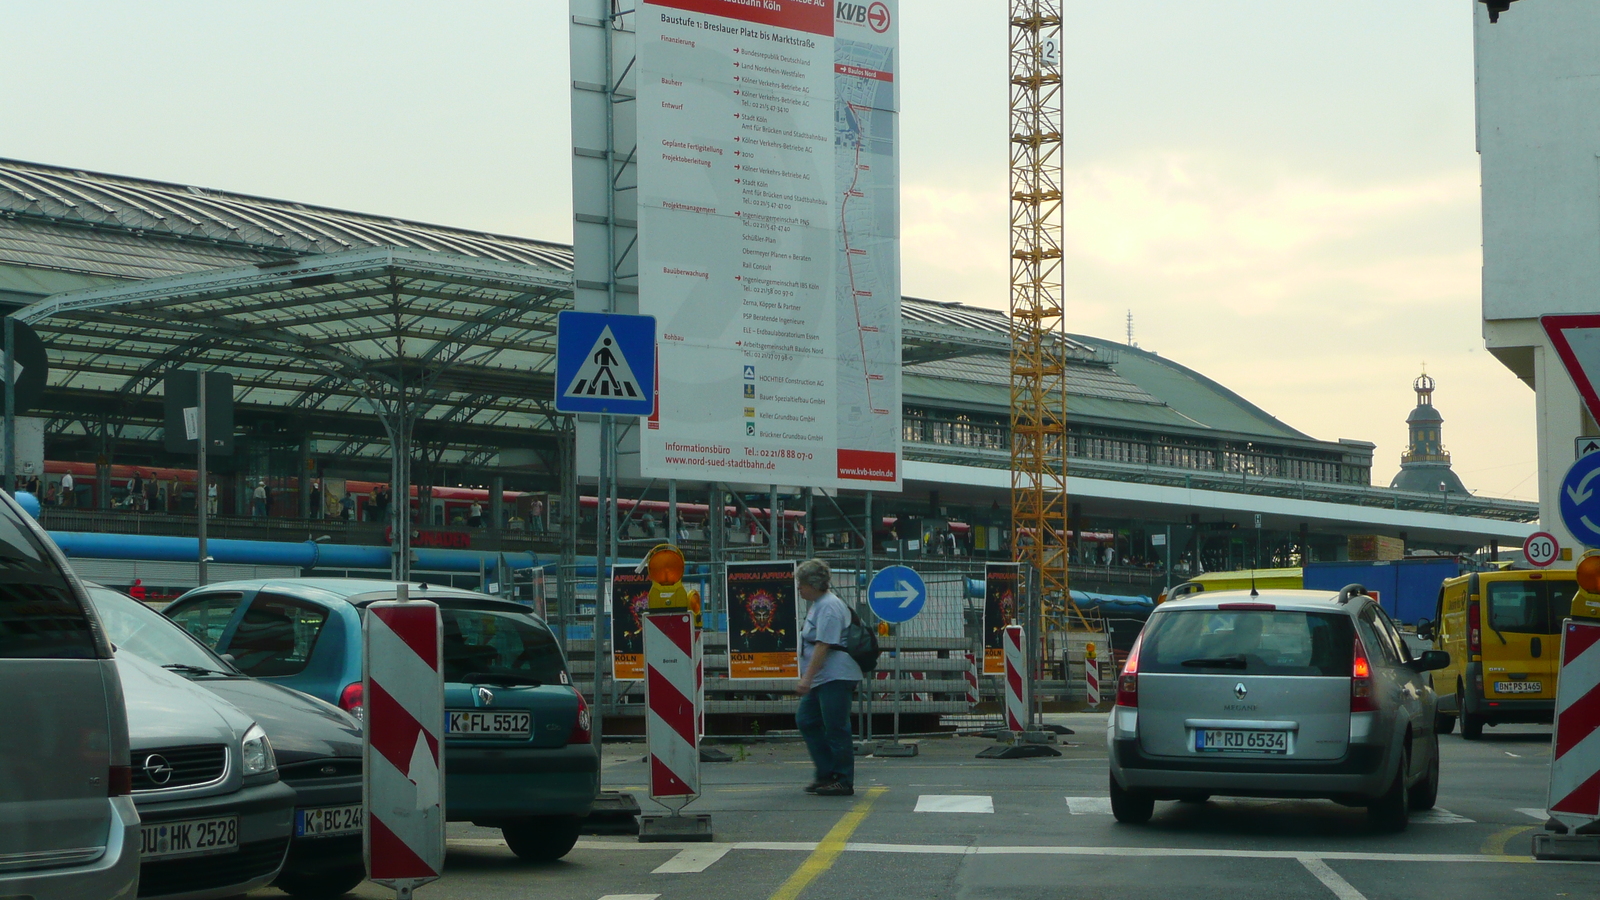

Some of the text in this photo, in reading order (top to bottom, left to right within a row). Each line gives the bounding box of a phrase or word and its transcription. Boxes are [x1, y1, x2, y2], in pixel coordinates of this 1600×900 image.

[763, 0, 781, 11] Köln
[836, 2, 866, 22] KVB
[660, 13, 815, 49] Baustufe 1: Breslauer Platz bis Marktstraße
[661, 35, 695, 48] Finanzierung
[1046, 41, 1054, 58] 2
[741, 48, 811, 66] Bundesrepublik Deutschland
[755, 64, 805, 79] Nordrhein-Westfalen
[865, 70, 876, 78] Nord
[661, 77, 682, 86] Bauherr
[759, 79, 801, 92] Verkehrs-Betriebe
[741, 90, 758, 98] Kölner
[759, 93, 801, 106] Verkehrs-Betriebe
[662, 101, 683, 110] Entwurf
[762, 126, 782, 134] Brücken
[783, 129, 793, 137] und
[793, 131, 827, 141] Stadtbahnbau
[662, 139, 723, 155] Geplante Fertigstellung
[742, 137, 758, 145] Kölner
[759, 140, 804, 152] Verkehrs-Betriebe
[662, 153, 711, 168] Projektoberleitung
[742, 165, 758, 173] Kölner
[759, 167, 801, 180] Verkehrs-Betriebe
[742, 179, 768, 188] Stadt Köln
[763, 191, 782, 199] Brücken
[663, 201, 716, 213] Projektmanagement
[742, 211, 799, 225] Ingenieurgemeinschaft
[742, 248, 770, 258] Obermeyer
[770, 251, 787, 259] Planen
[663, 267, 709, 279] Bauüberwachung
[753, 263, 771, 271] Consult
[743, 276, 799, 287] Ingenieurgemeinschaft
[783, 303, 801, 311] Partner
[753, 314, 778, 322] Beratende
[779, 317, 805, 325] Ingenieure
[664, 333, 684, 341] Rohbau
[757, 328, 805, 339] Erdbaulaboratorium
[743, 341, 794, 351] Arbeitsgemeinschaft
[785, 377, 816, 386] Construction
[775, 395, 809, 404] Spezialtiefbau
[782, 432, 807, 440] Grundbau
[665, 442, 813, 461] Informationsbüro Tel.: 02 21/8 88 07-0
[665, 455, 776, 470] www.nord-sued-stadtbahn.de
[840, 467, 893, 478] www.kvb-koeln.de
[1530, 542, 1551, 558] 30
[451, 714, 529, 731] K FL 5512
[1205, 730, 1284, 748] M RD 6534
[306, 812, 314, 832] K
[324, 810, 341, 830] BC
[171, 824, 192, 850] HK
[197, 819, 235, 847] 2528
